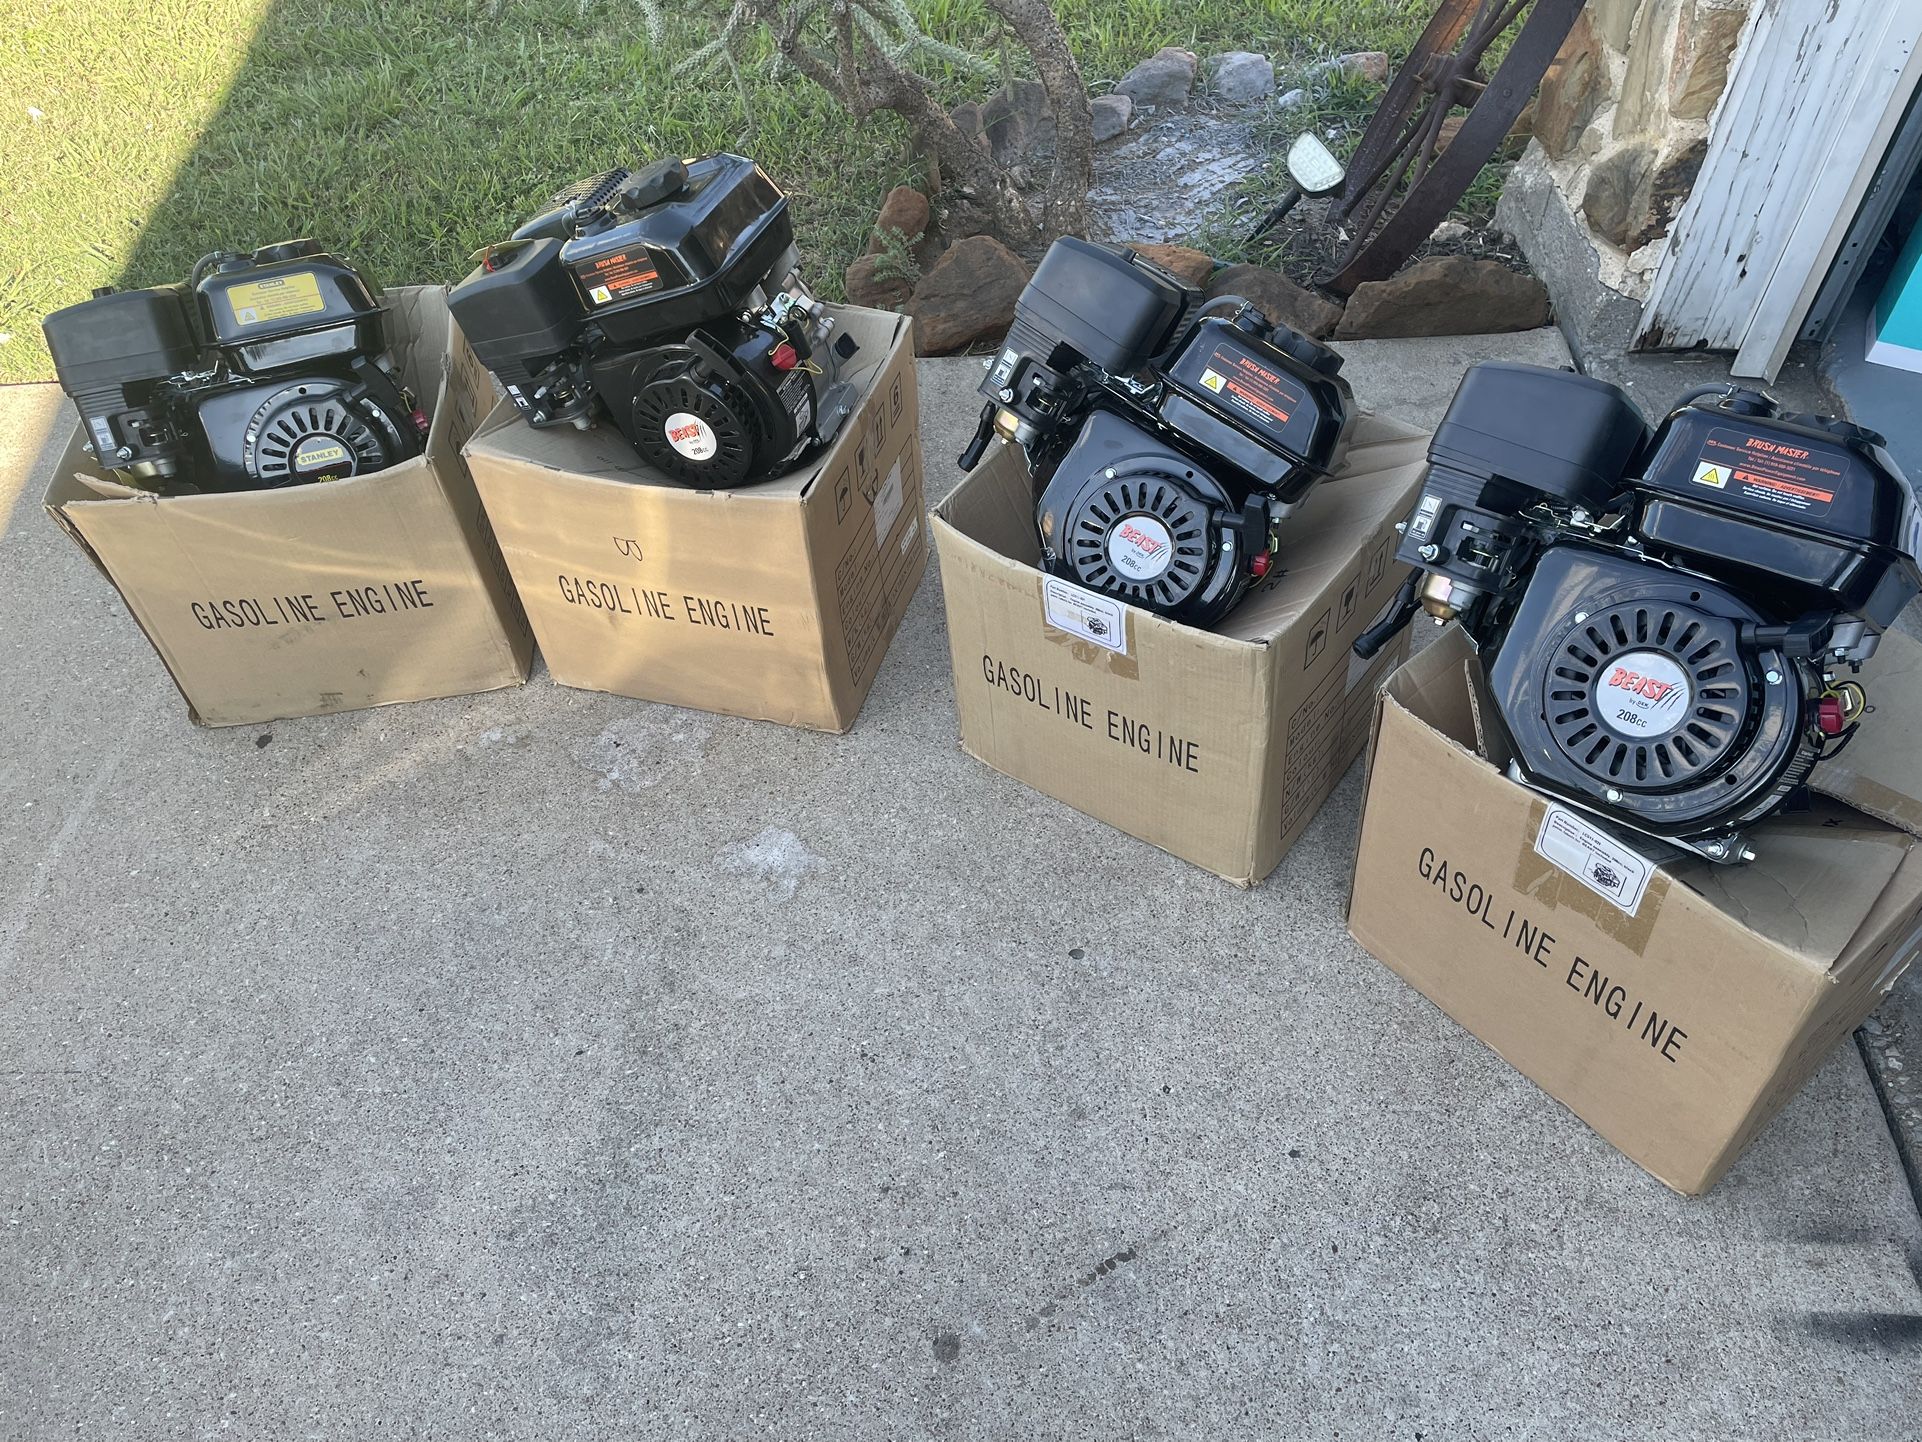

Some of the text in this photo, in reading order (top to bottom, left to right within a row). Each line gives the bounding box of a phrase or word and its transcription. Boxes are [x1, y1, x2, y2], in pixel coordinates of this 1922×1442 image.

[301, 449, 339, 463] STANLEY
[1746, 438, 1809, 460] BRUSH MASTER
[1119, 524, 1162, 555] BEAST
[1121, 555, 1142, 572] 208cc
[191, 579, 434, 630] GASOLINE ENGINE
[558, 575, 774, 636] GASOLINE ENGINE
[1608, 667, 1674, 702] BEAST
[983, 655, 1200, 773] GASOLINE ENGINE
[1617, 709, 1647, 728] 208cc
[1418, 847, 1688, 1063] GASOLINE ENGINE
